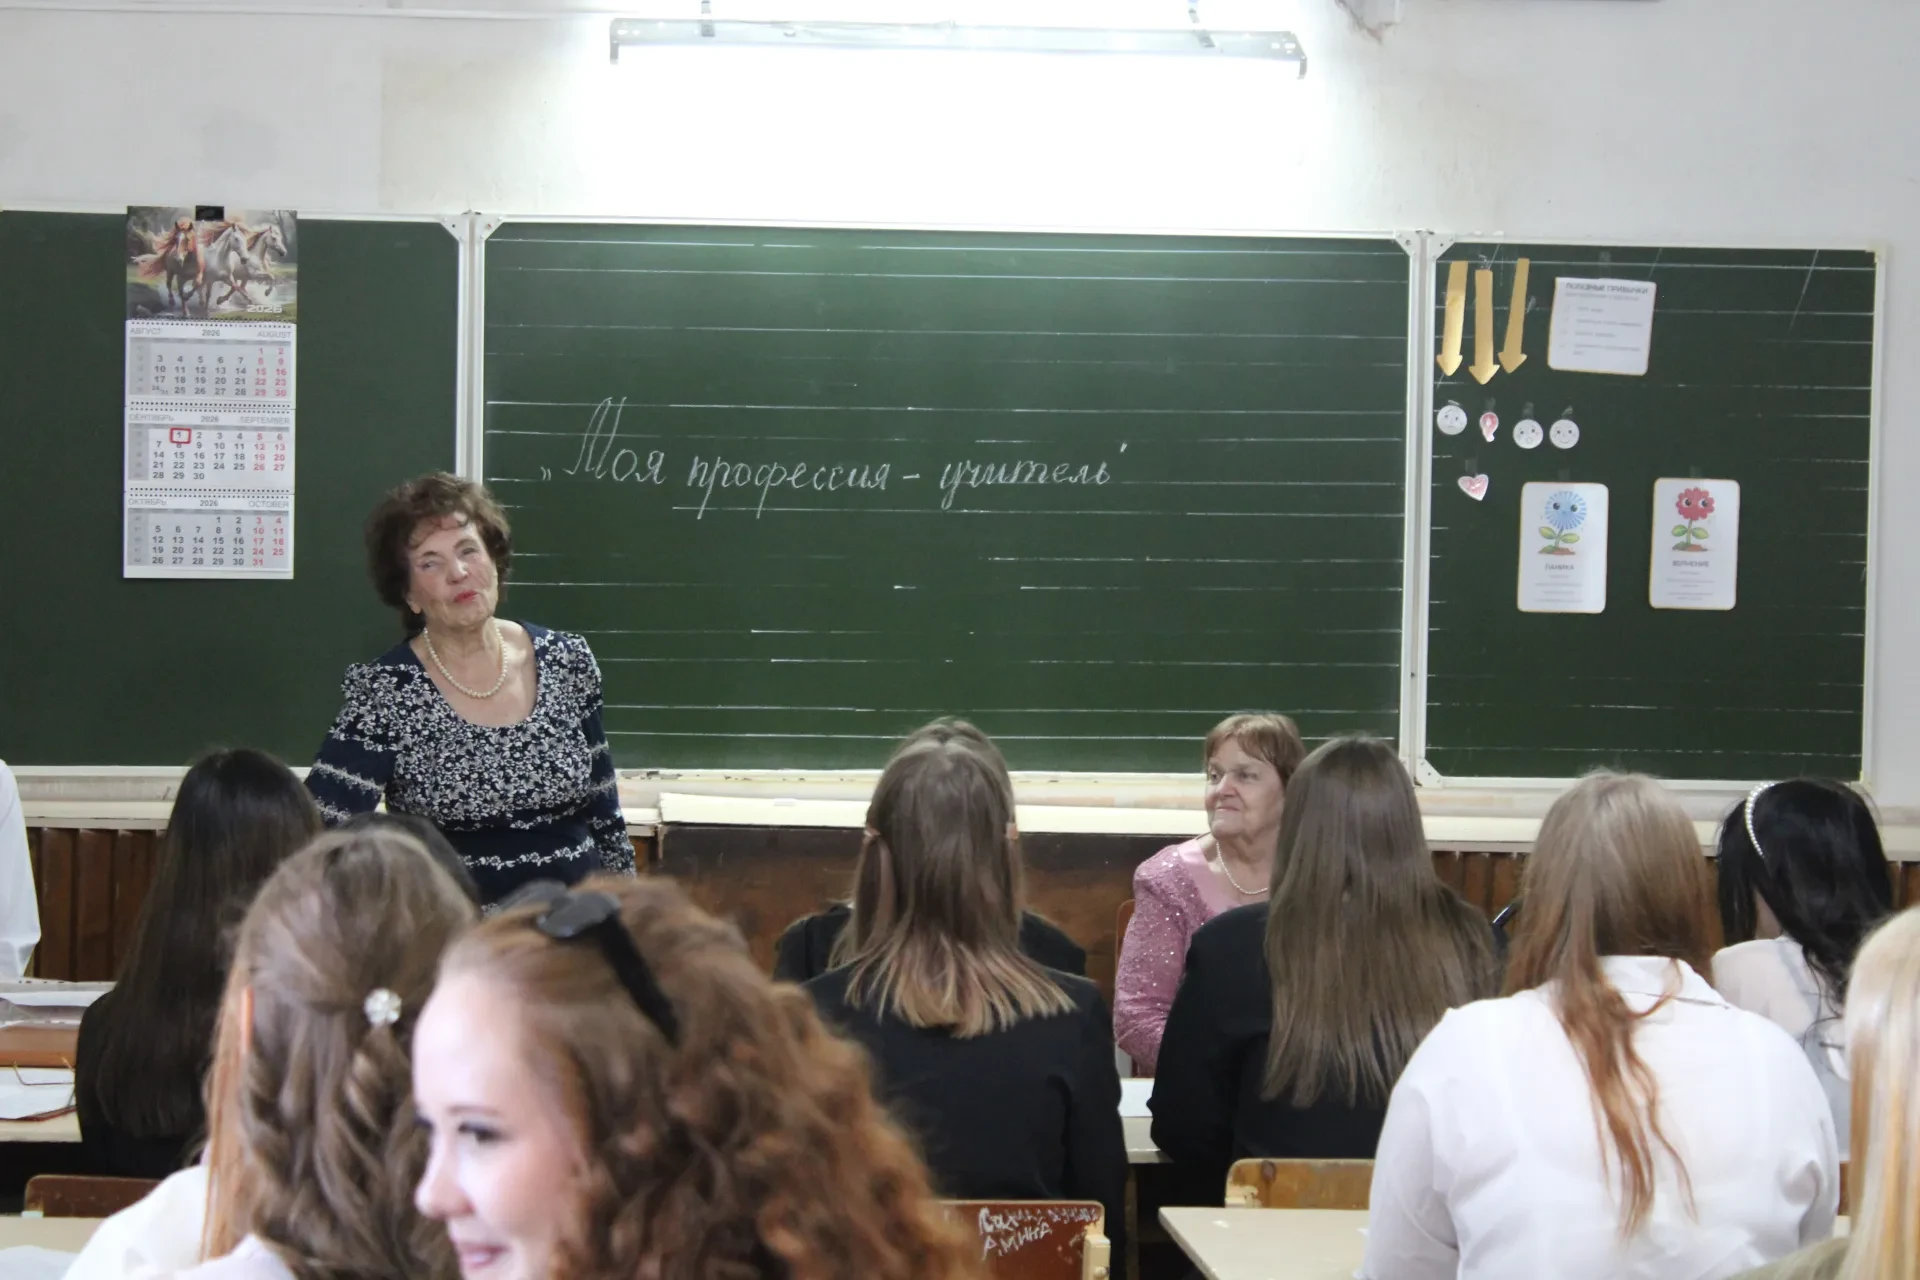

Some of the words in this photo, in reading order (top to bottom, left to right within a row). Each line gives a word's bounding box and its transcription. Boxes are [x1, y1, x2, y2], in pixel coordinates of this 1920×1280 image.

[154, 365, 166, 373] 10
[174, 366, 186, 374] 11
[195, 366, 207, 374] 12
[215, 366, 227, 375] 13
[235, 367, 247, 375] 14
[255, 367, 267, 376] 15
[275, 368, 287, 376] 16
[154, 375, 166, 384] 17
[174, 376, 186, 384] 18
[195, 376, 207, 384] 19
[214, 377, 227, 385] 20
[234, 377, 247, 385] 21
[254, 378, 267, 386] 22
[275, 378, 287, 386] 23
[174, 386, 186, 395] 25
[194, 387, 206, 395] 26
[214, 387, 226, 396] 27
[234, 388, 246, 396] 28
[254, 388, 267, 397] 29
[275, 389, 287, 397] 30
[214, 442, 226, 450] 10
[234, 442, 246, 450] 11
[254, 443, 266, 451] 12
[274, 443, 286, 452] 13
[153, 451, 165, 459] 14
[173, 451, 185, 460] 15
[193, 452, 205, 460] 16
[213, 452, 226, 460] 17
[234, 452, 246, 461] 18
[254, 453, 266, 461] 19
[273, 453, 285, 462] 20
[152, 461, 165, 469] 21
[173, 461, 185, 469] 22
[193, 462, 205, 470] 23
[213, 462, 225, 470] 24
[233, 463, 245, 471] 25
[253, 463, 265, 471] 26
[273, 463, 285, 472] 27
[152, 471, 165, 479] 28
[173, 471, 185, 480] 29
[193, 472, 205, 480] 30
[688, 452, 888, 520] профессия
[253, 527, 265, 535] 10
[273, 527, 285, 536] 11
[152, 536, 164, 544] 12
[172, 536, 184, 544] 13
[192, 536, 204, 544] 14
[212, 536, 224, 545] 15
[232, 537, 245, 545] 16
[252, 537, 265, 545] 17
[152, 546, 164, 554] 19
[172, 546, 184, 554] 20
[192, 546, 204, 555] 21
[212, 547, 224, 555] 22
[232, 547, 244, 556] 23
[252, 547, 264, 556] 24
[272, 548, 284, 556] 25
[152, 556, 164, 564] 26
[172, 556, 184, 565] 27
[192, 557, 204, 565] 28
[212, 557, 224, 566] 29
[232, 558, 244, 566] 30
[252, 558, 264, 566] 31
